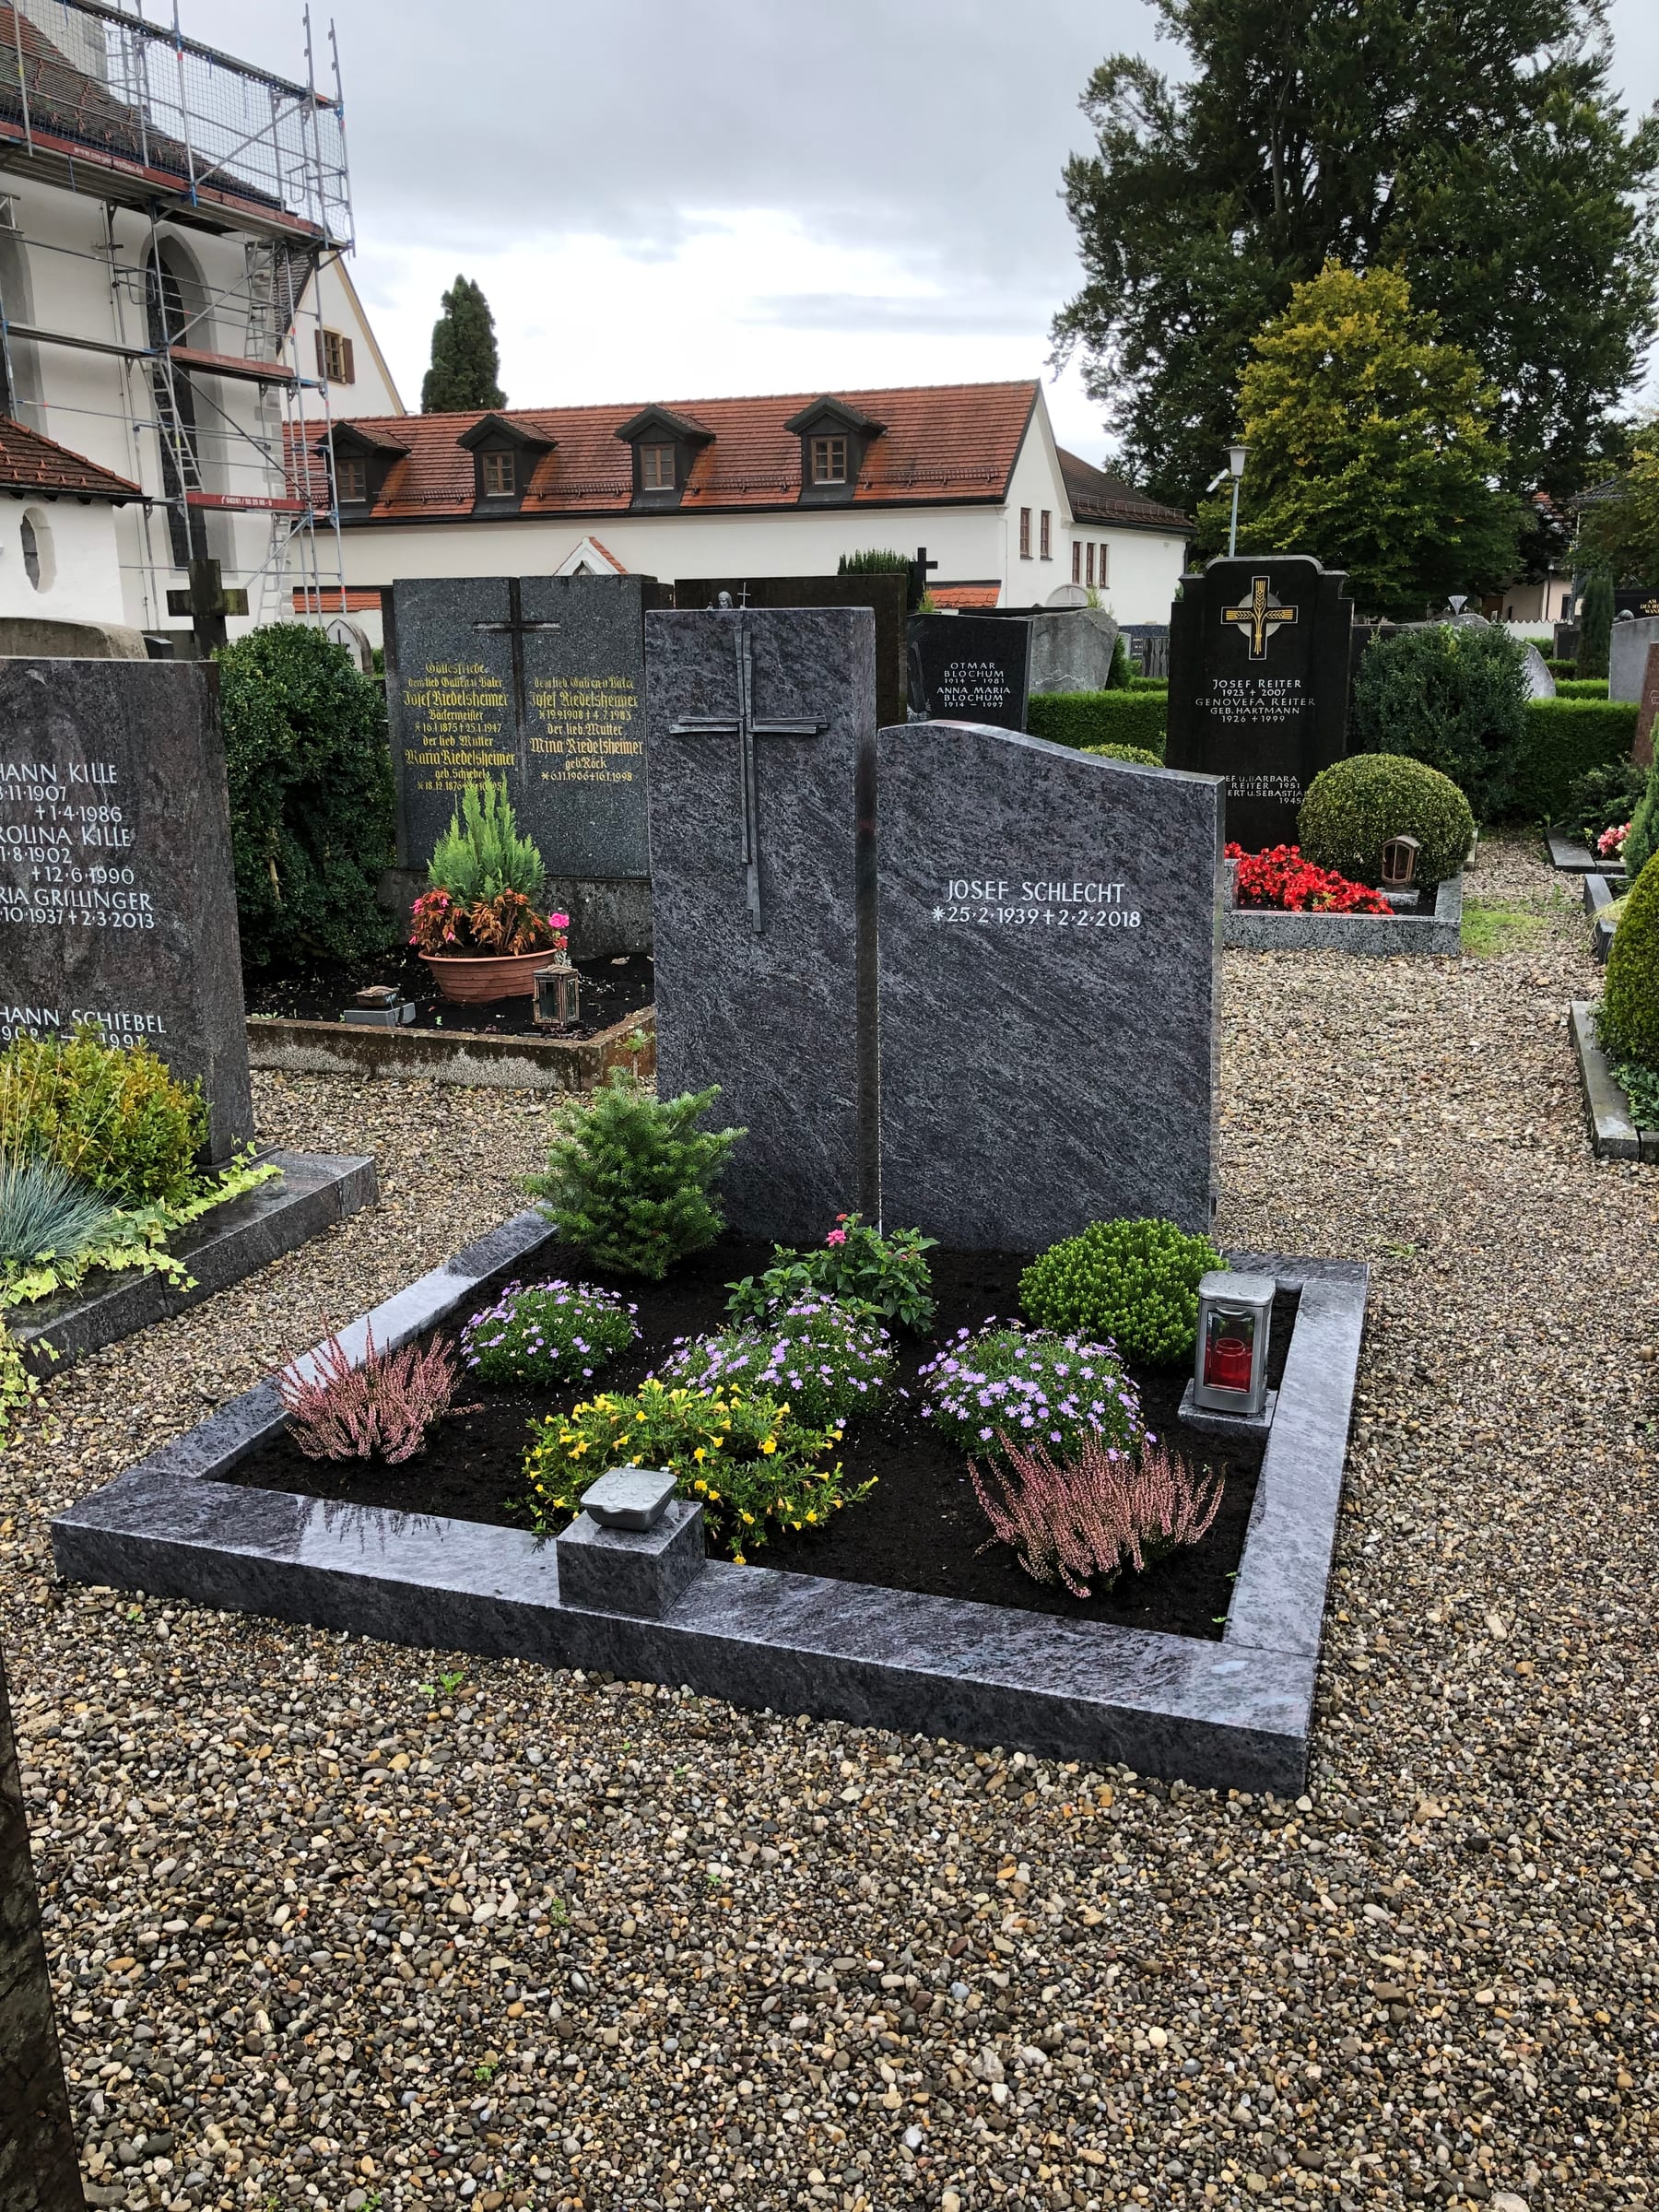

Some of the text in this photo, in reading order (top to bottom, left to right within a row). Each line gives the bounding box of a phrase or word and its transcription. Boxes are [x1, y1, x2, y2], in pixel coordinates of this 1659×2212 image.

[950, 662, 995, 670] OTMAR
[1212, 678, 1301, 689] JOSEF REITER
[1195, 698, 1315, 706] GENOVEFA REITER
[547, 724, 563, 735] der
[585, 724, 623, 735] Mutter
[422, 735, 437, 747] der
[459, 735, 493, 747] Mutter
[565, 738, 643, 755] Riedelsheimer
[406, 749, 515, 767] Maria Riedelsheimer
[68, 763, 118, 783] KILLE
[1231, 782, 1269, 790] REITER
[81, 826, 131, 847] KILLE
[34, 888, 153, 911] GRILLINGER
[945, 879, 1125, 903] JOSEF SCHLECHT
[71, 1009, 167, 1034] SCHIEBEL
